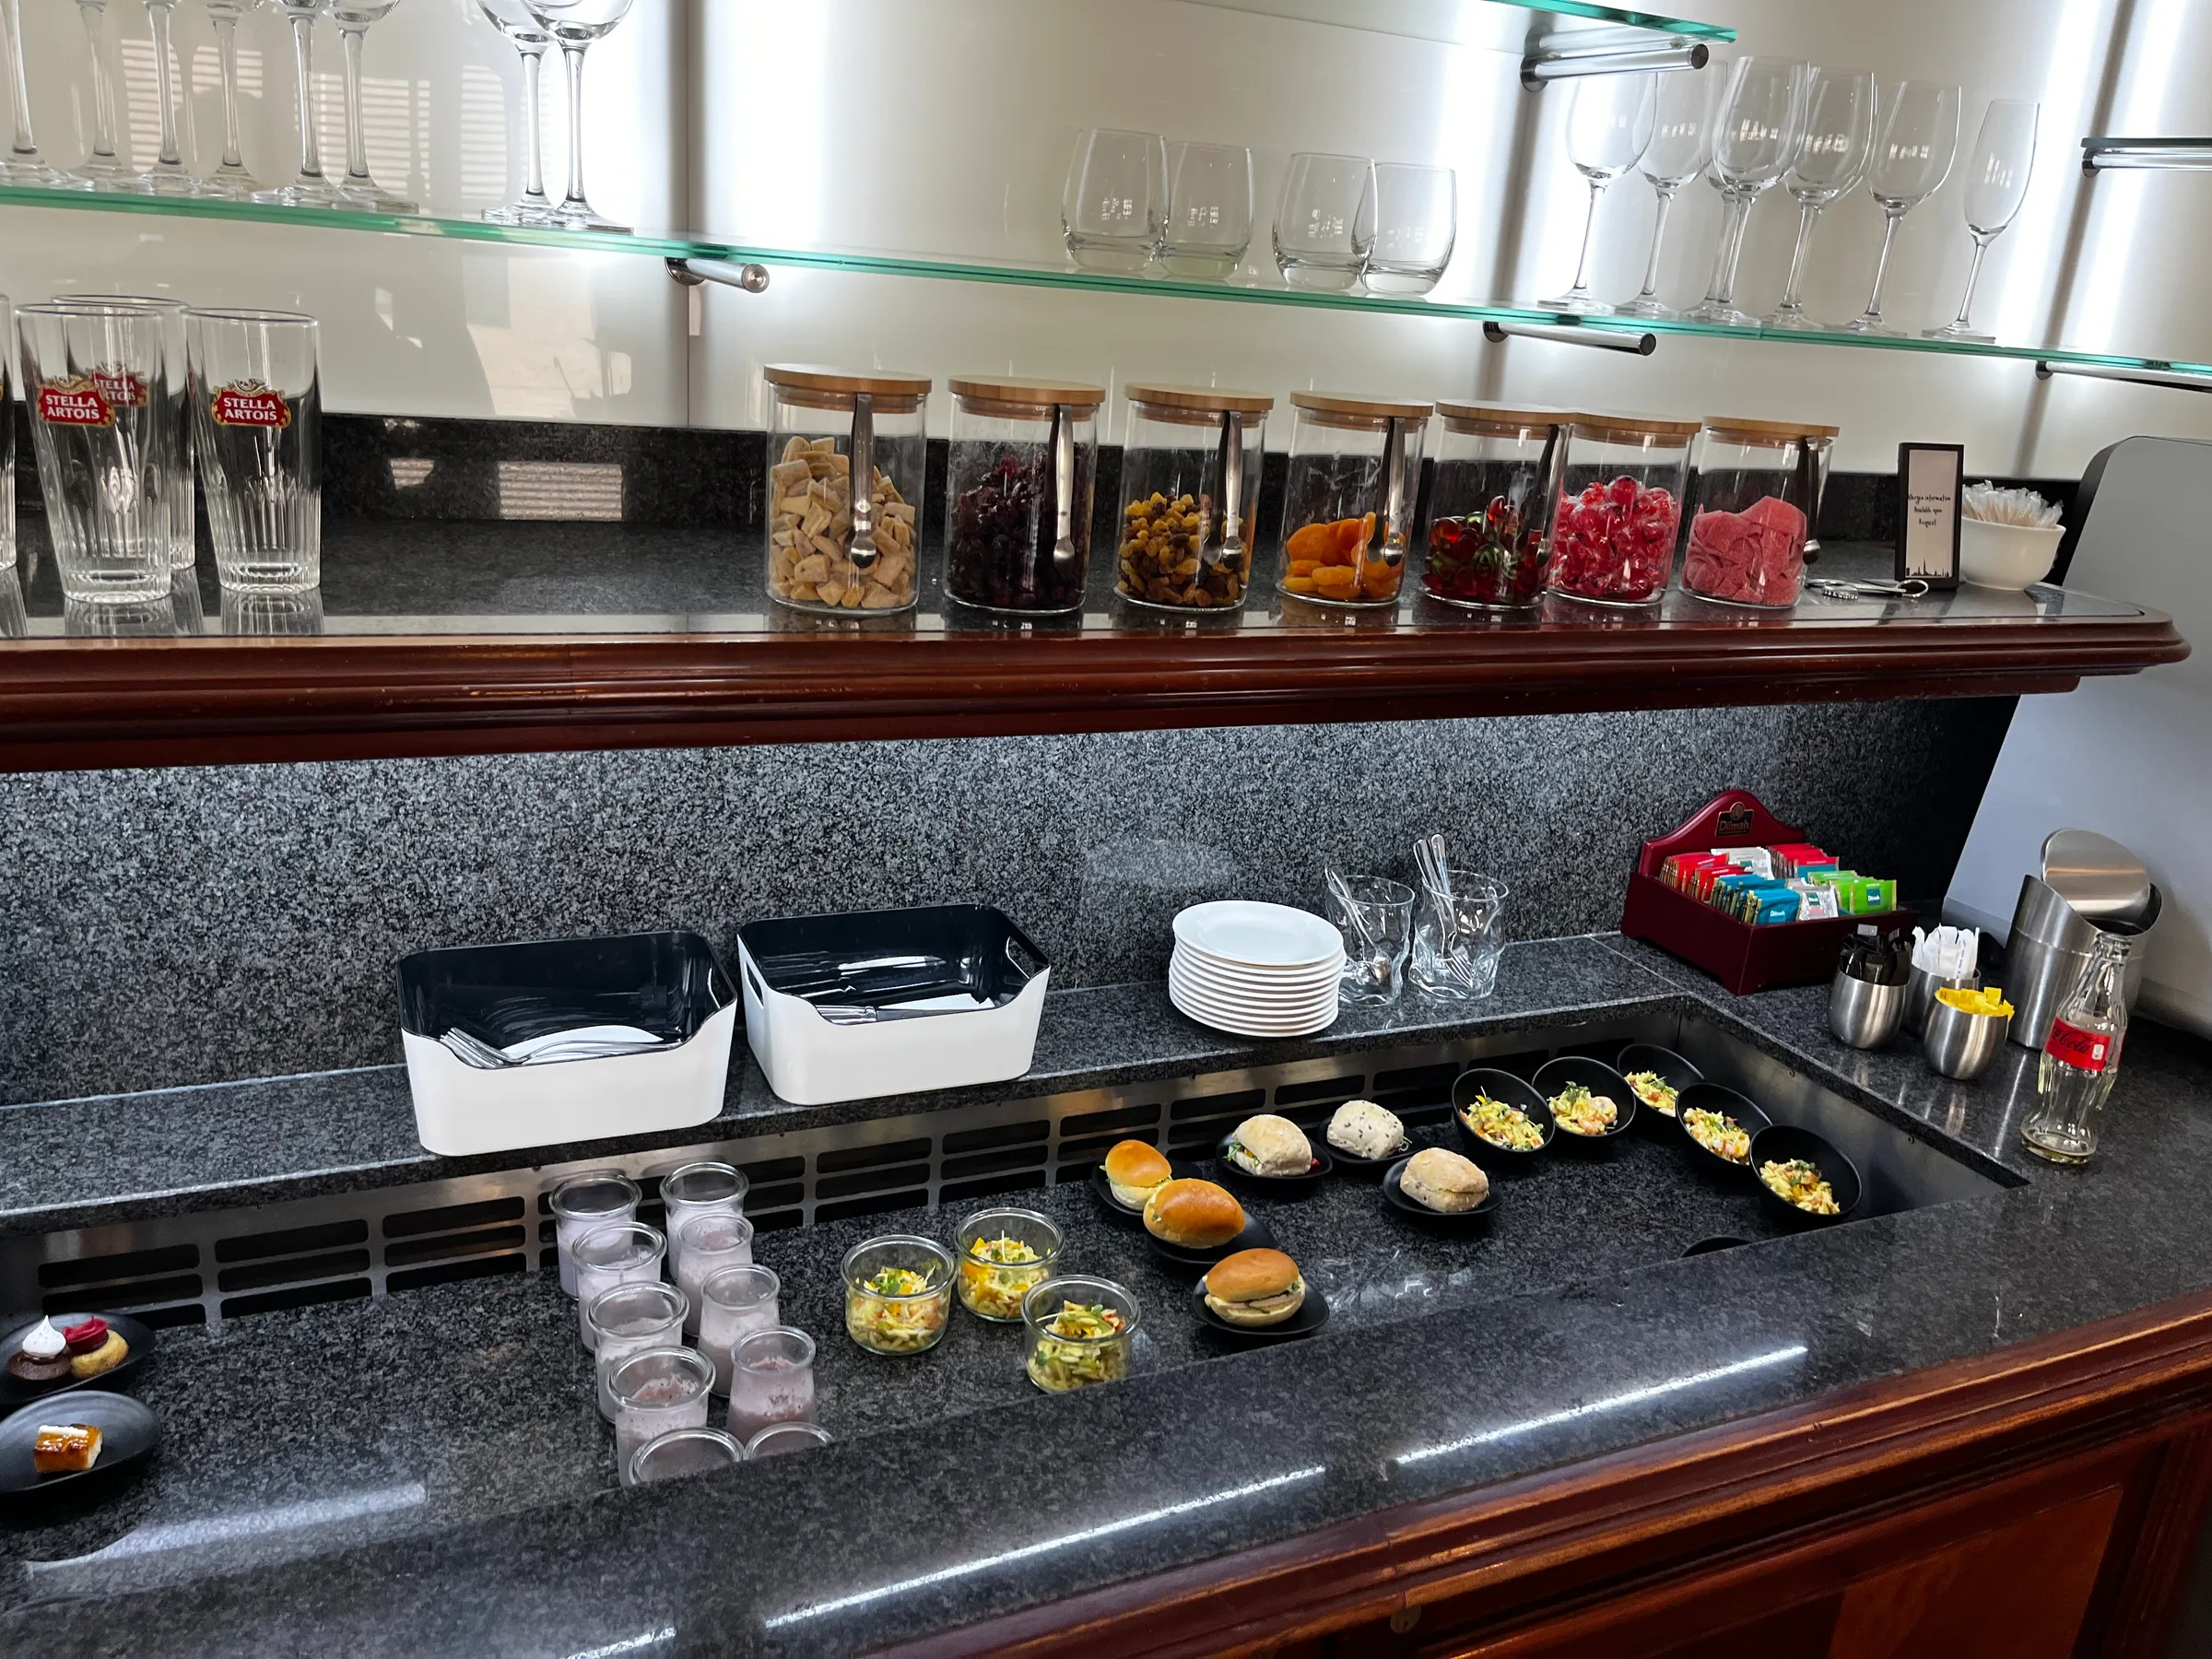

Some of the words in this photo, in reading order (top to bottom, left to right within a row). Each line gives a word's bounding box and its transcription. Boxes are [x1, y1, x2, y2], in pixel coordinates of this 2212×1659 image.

[95, 379, 135, 390] STELLA
[45, 394, 98, 407] STELLA
[106, 391, 135, 401] RTOIS
[224, 397, 276, 409] STELLA
[47, 406, 100, 419] ARTOIS
[225, 409, 277, 421] ARTOIS
[1719, 819, 1749, 831] Dilmah
